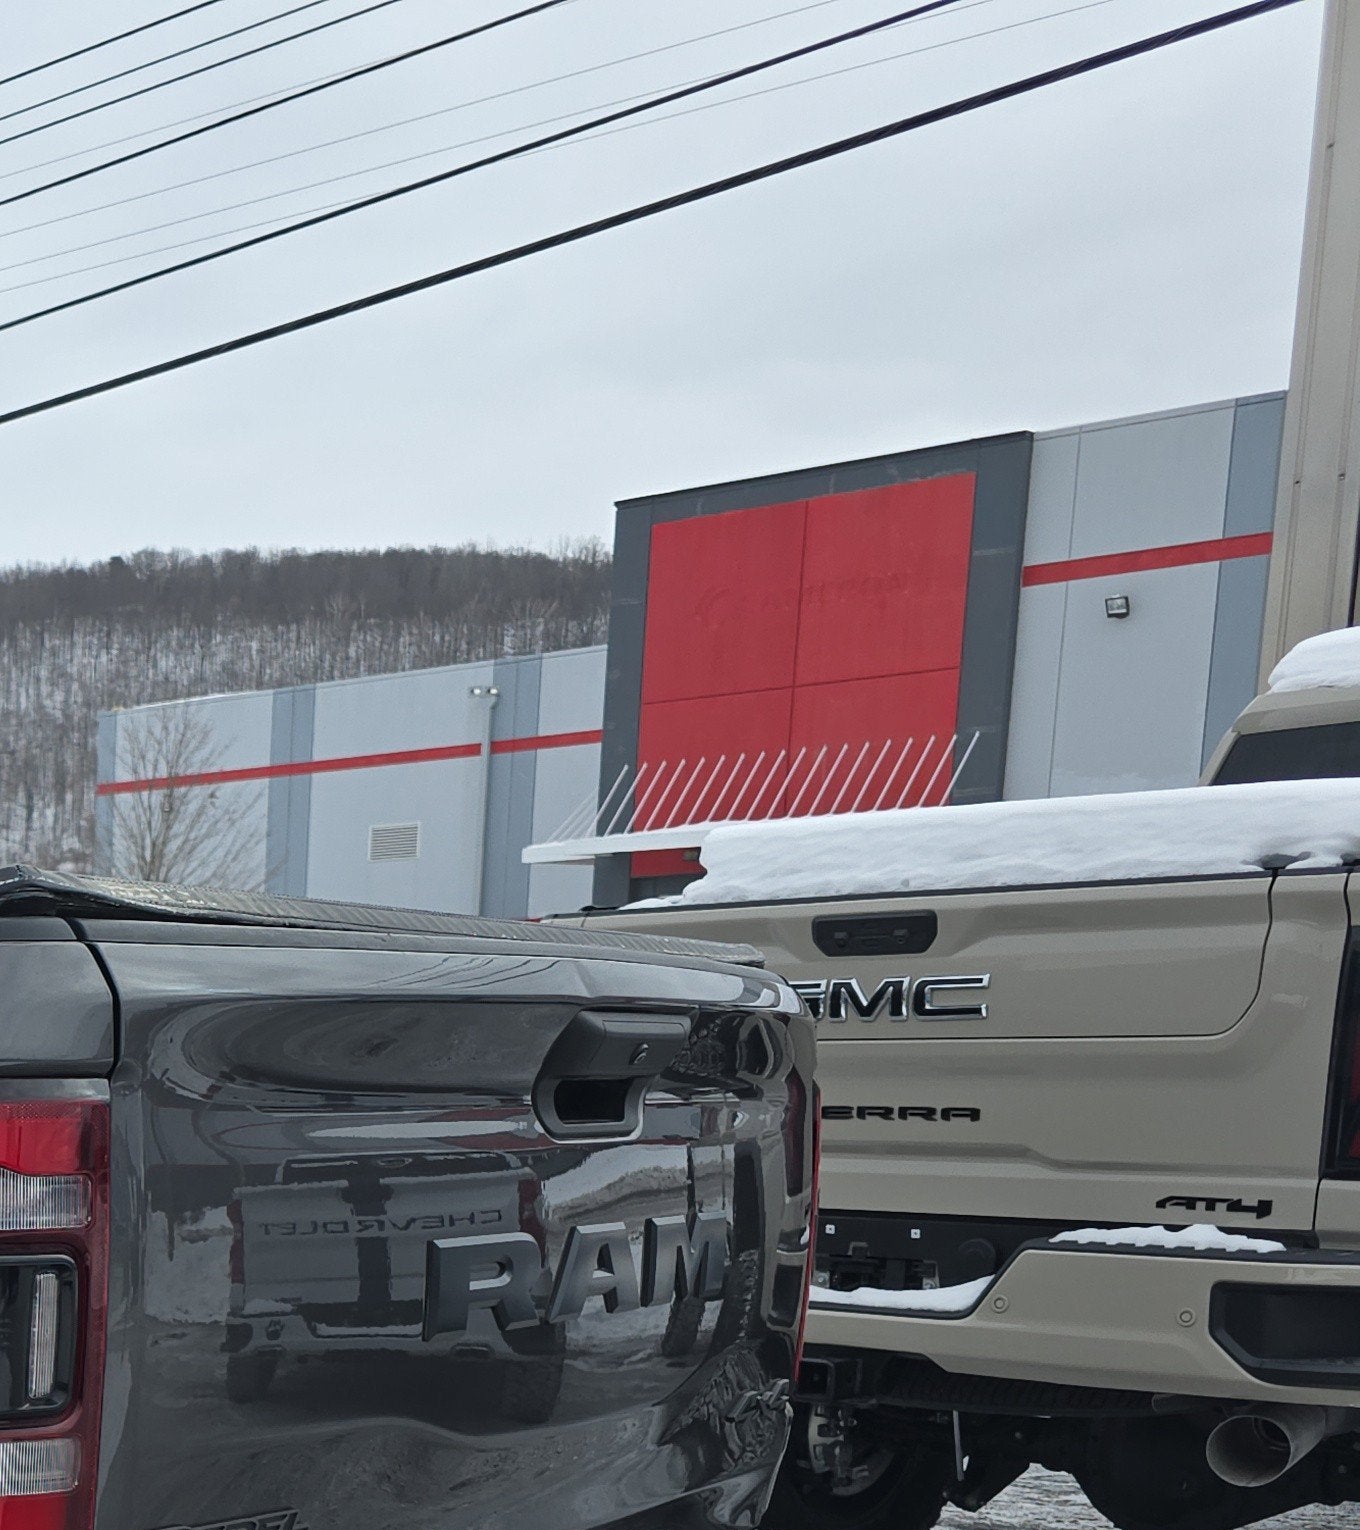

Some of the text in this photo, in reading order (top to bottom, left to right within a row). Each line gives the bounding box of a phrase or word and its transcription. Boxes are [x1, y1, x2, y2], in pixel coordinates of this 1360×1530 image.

[821, 1105, 981, 1122] ERRA
[1156, 1195, 1273, 1220] AT4
[422, 1211, 731, 1341] RAM
